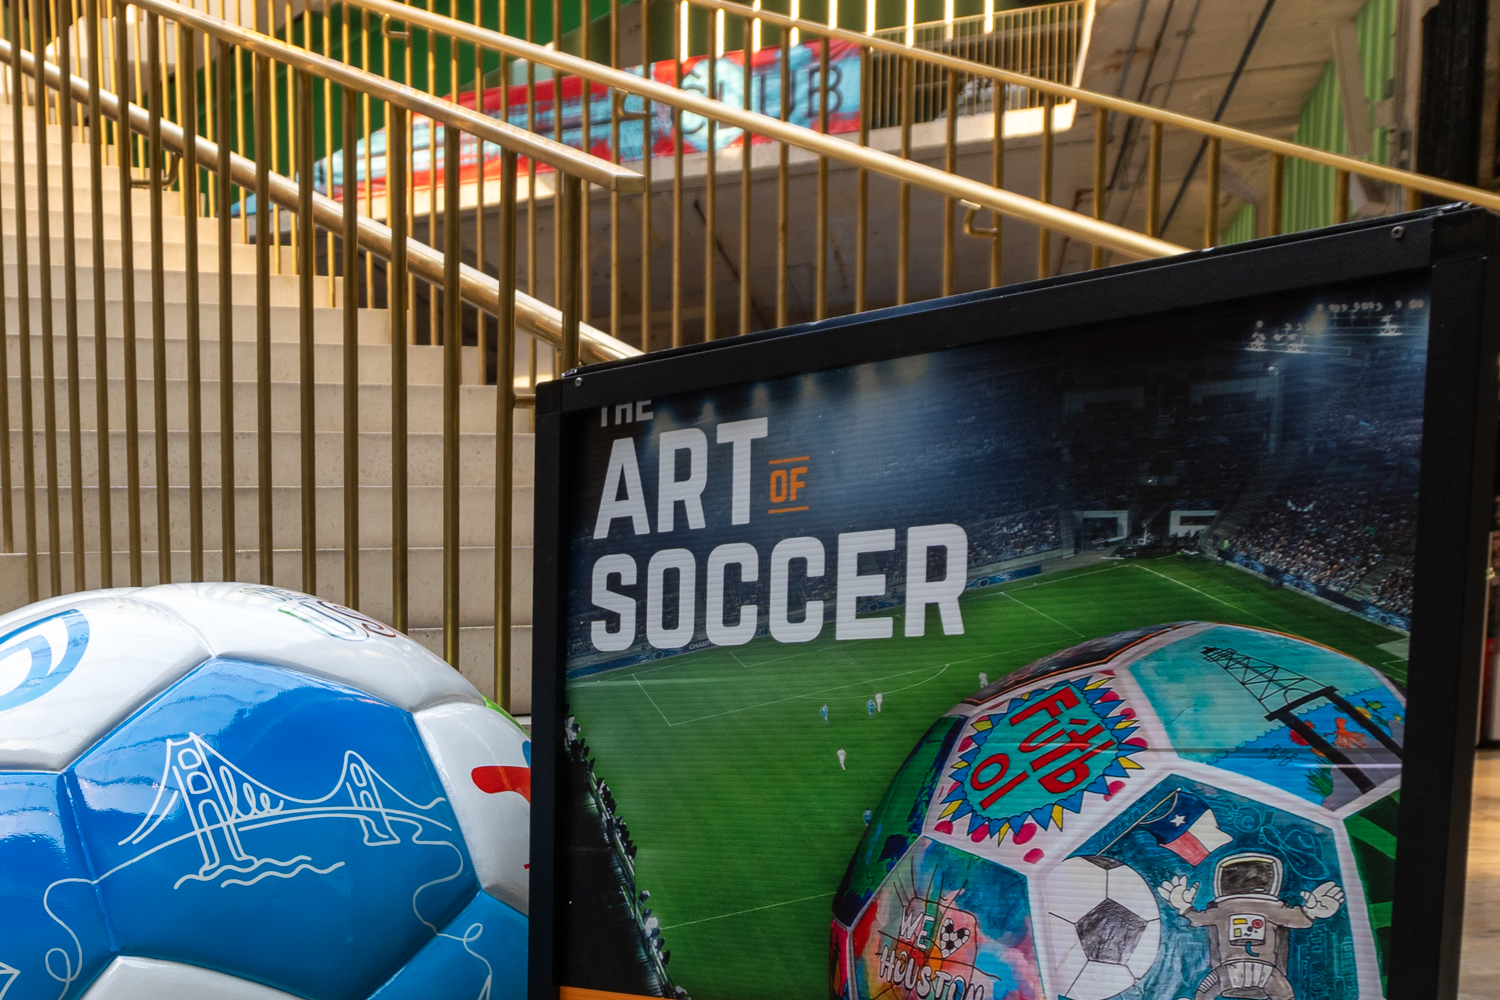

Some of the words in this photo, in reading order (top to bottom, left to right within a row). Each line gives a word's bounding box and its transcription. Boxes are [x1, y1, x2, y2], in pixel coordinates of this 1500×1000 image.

[593, 417, 768, 539] ART
[770, 466, 808, 503] OF
[590, 523, 969, 652] SOCCER
[900, 905, 935, 950] WE
